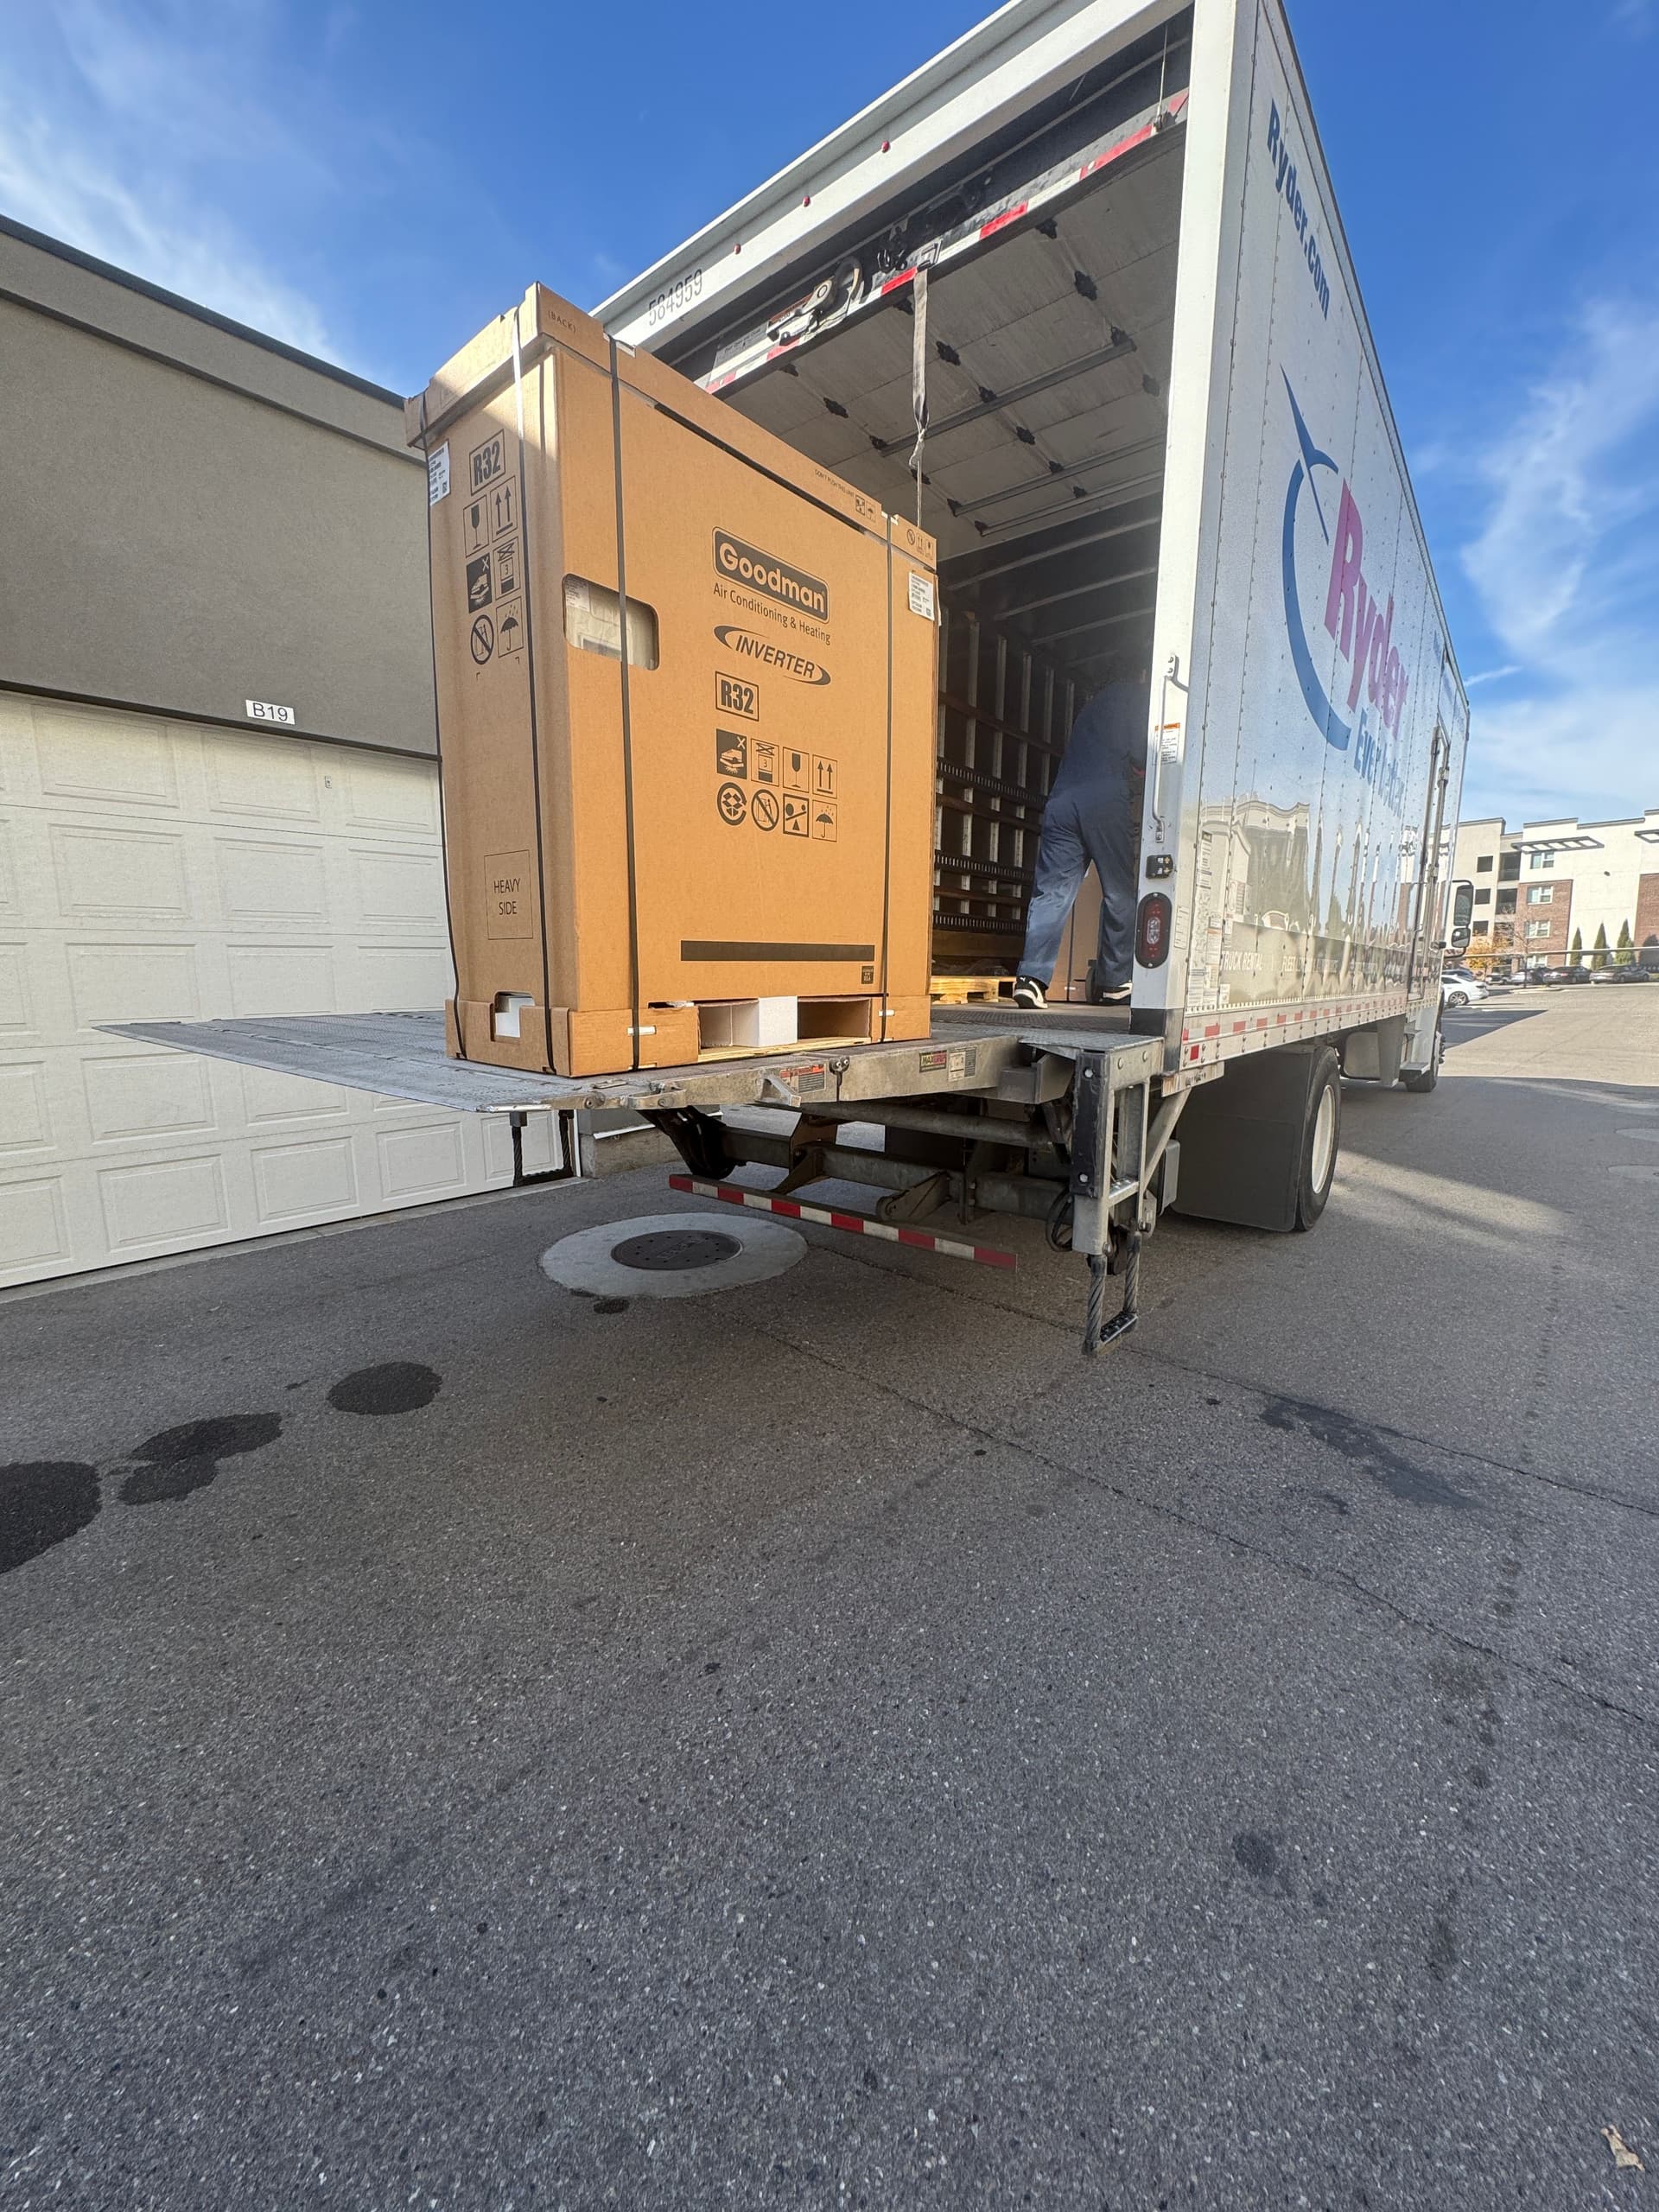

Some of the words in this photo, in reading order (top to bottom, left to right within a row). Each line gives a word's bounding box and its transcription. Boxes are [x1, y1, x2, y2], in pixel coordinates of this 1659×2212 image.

[1267, 97, 1331, 321] Ryder.com
[648, 268, 702, 327] 584959
[473, 440, 501, 486] R32
[719, 542, 825, 613] Goodman
[713, 582, 728, 600] Air
[729, 589, 789, 629] Conditioning
[790, 616, 797, 629] &
[799, 619, 830, 646] Heating
[1324, 477, 1408, 741] Ryder
[735, 634, 816, 679] INVERTER
[252, 702, 289, 722] B19
[721, 679, 754, 715] R32
[494, 878, 520, 893] HEAVY
[499, 901, 518, 915] SIDE
[1219, 950, 1243, 971] TRUCK
